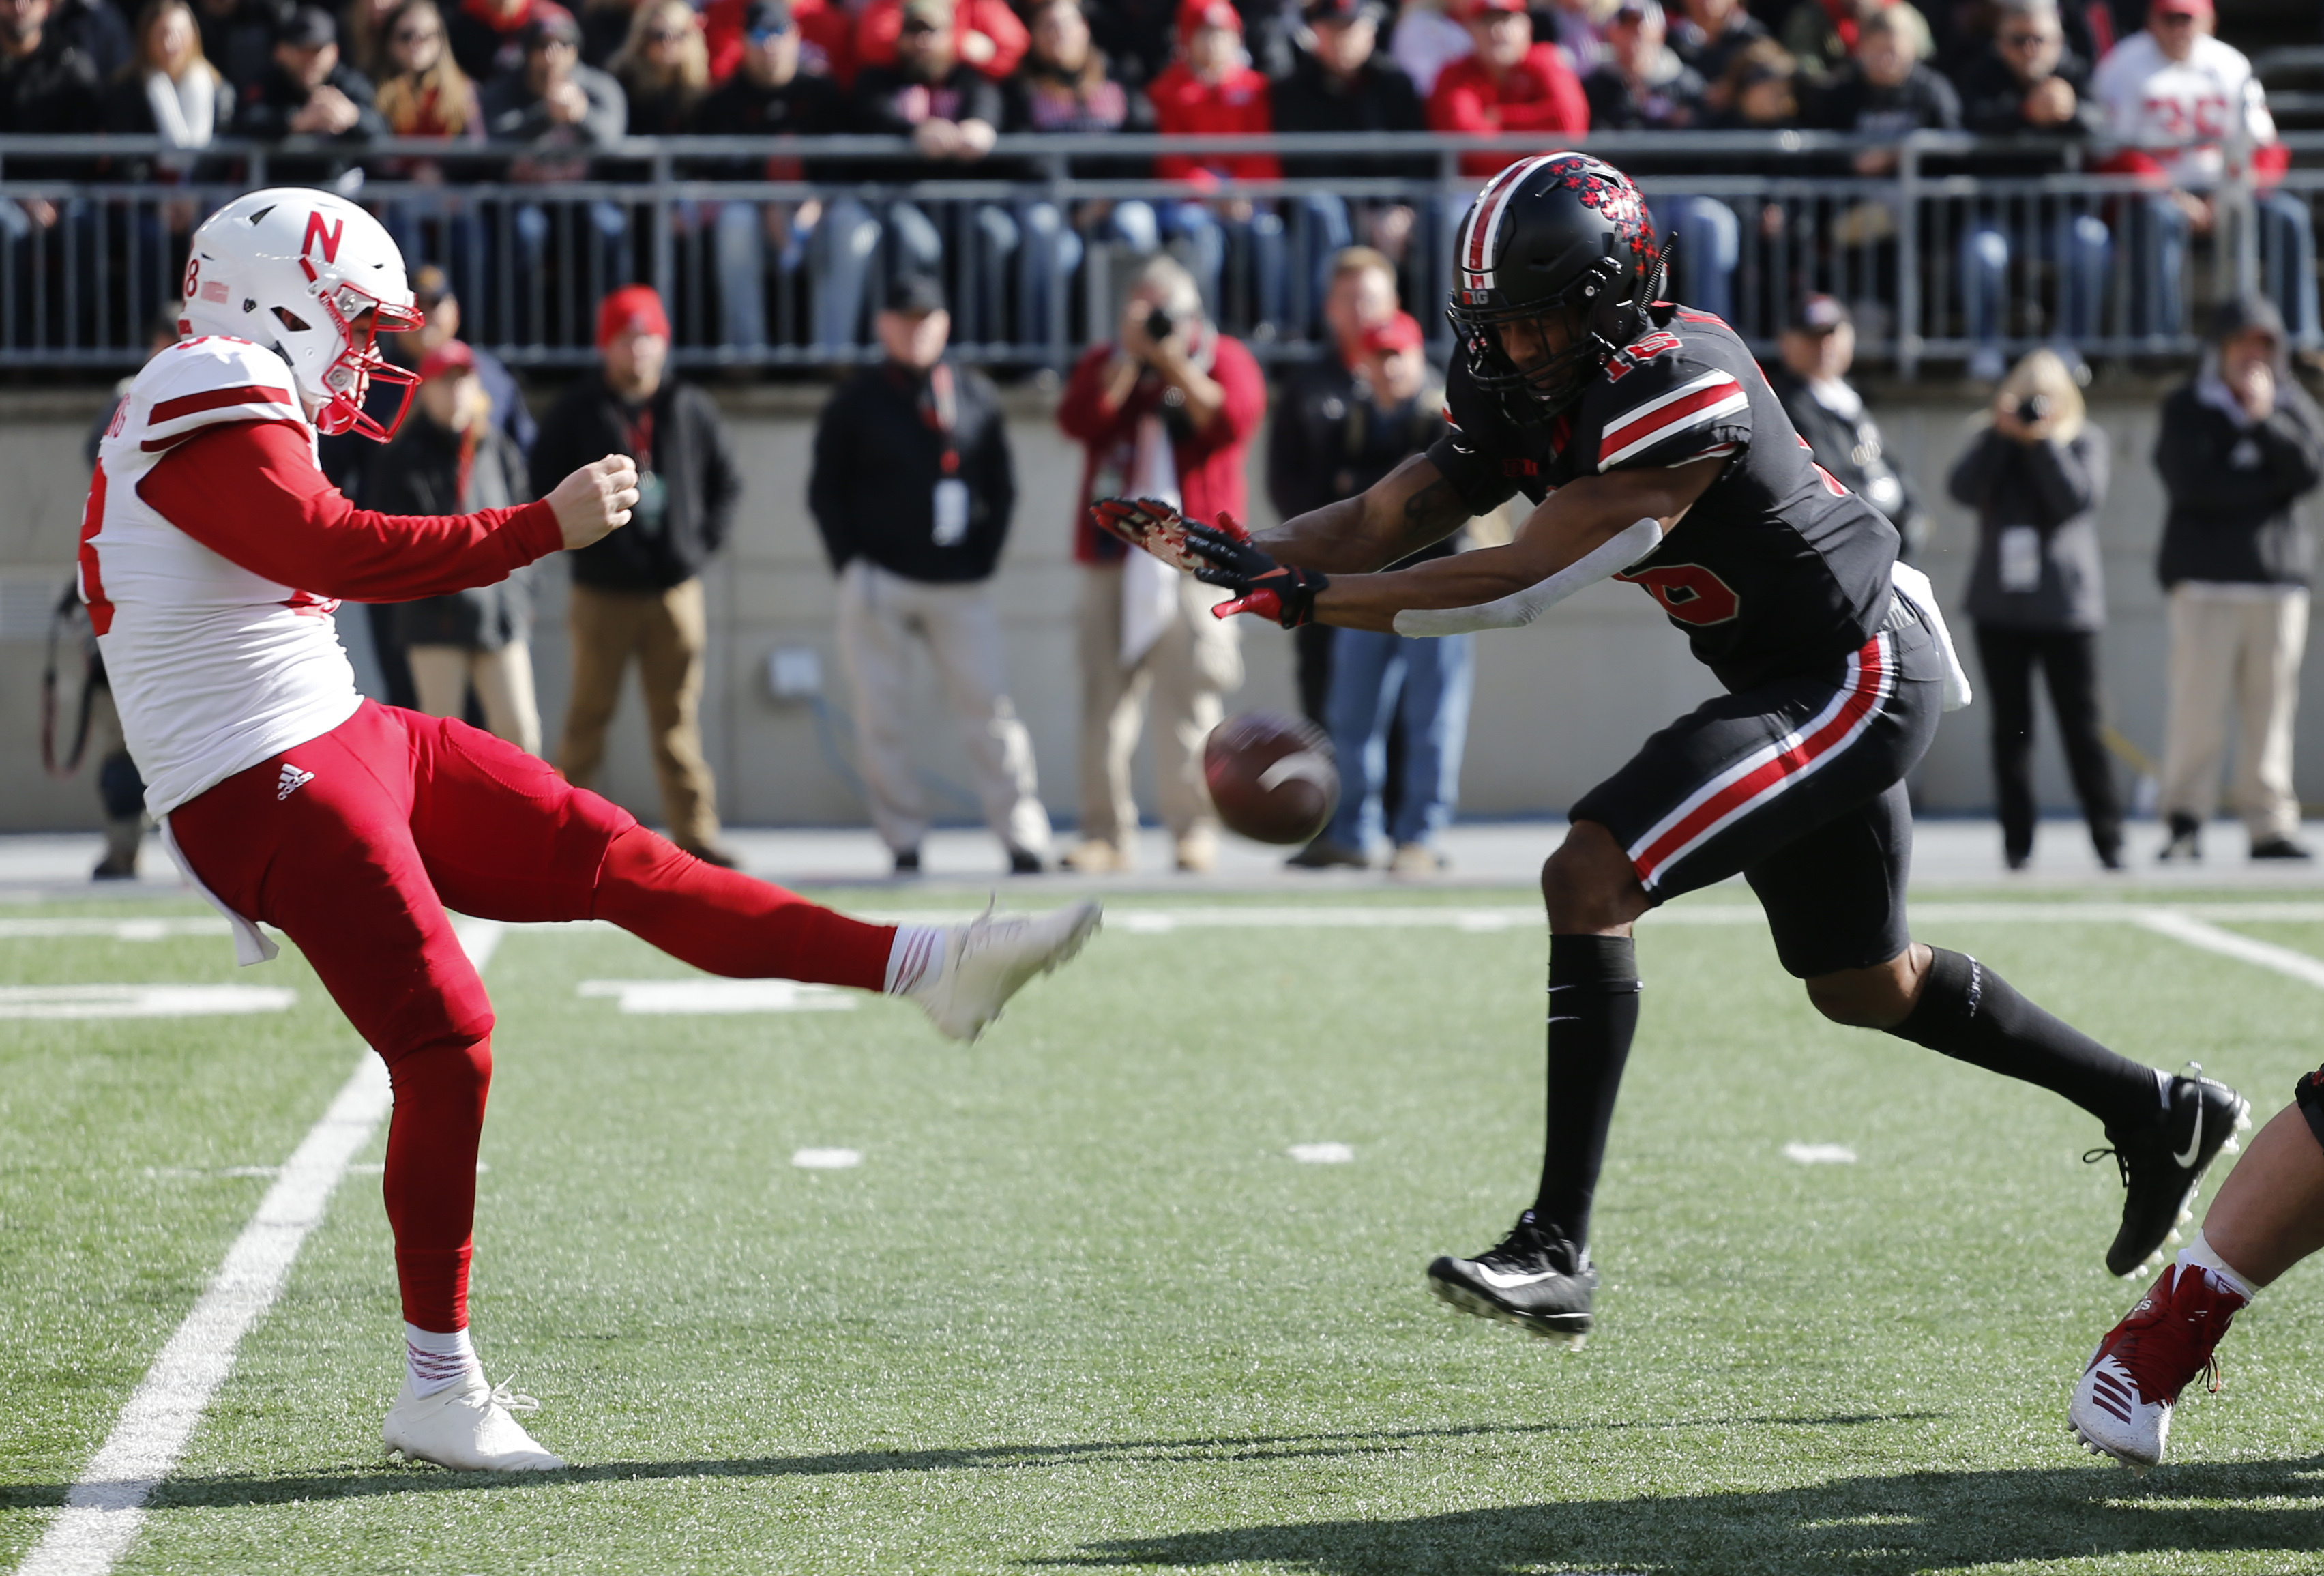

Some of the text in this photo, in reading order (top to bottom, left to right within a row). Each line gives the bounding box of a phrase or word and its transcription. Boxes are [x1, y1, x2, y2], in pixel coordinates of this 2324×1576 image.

[301, 210, 344, 263] N
[1604, 331, 1683, 383] 16
[277, 771, 315, 801] adidas
